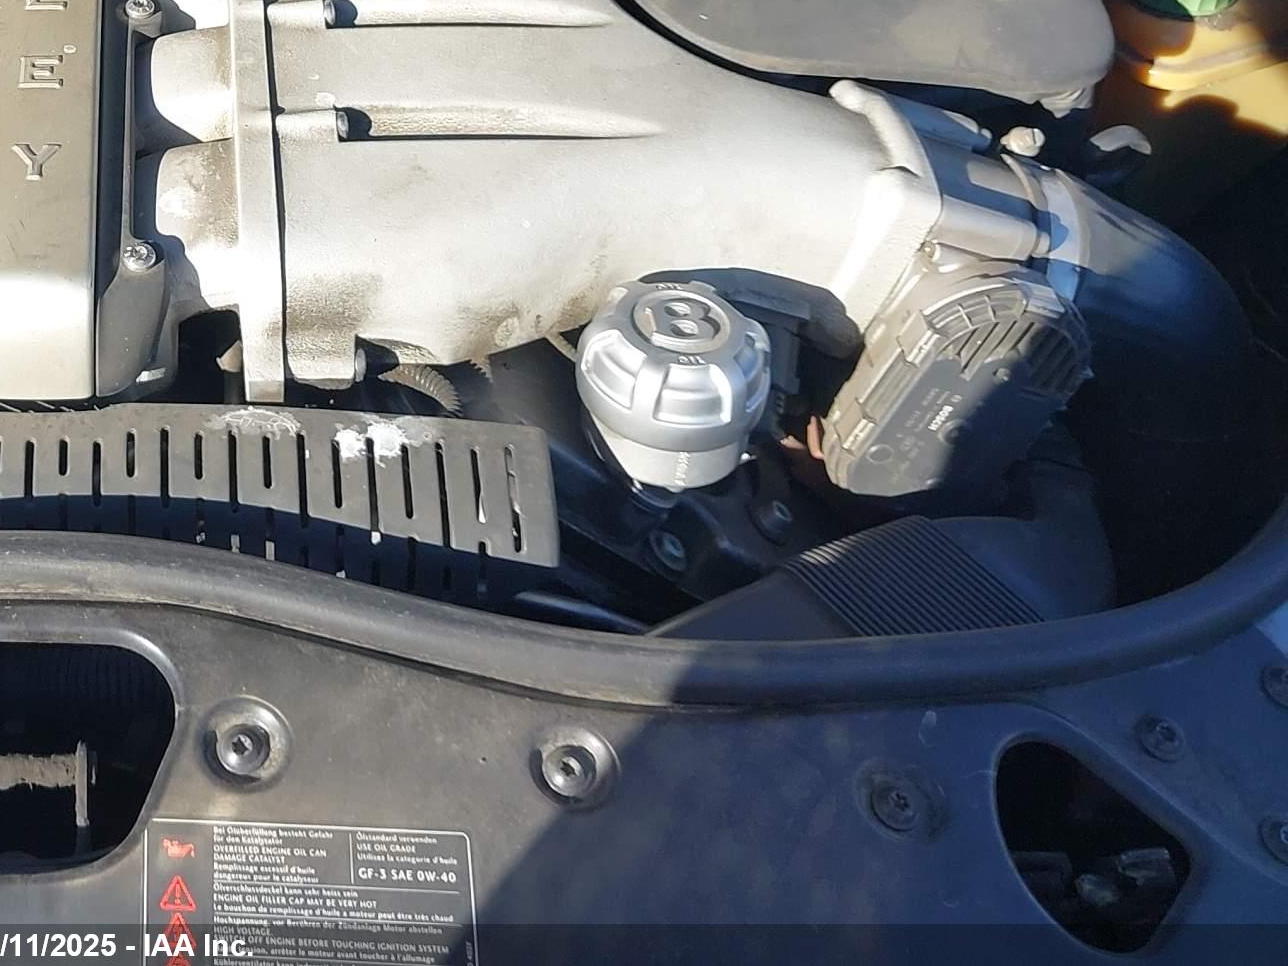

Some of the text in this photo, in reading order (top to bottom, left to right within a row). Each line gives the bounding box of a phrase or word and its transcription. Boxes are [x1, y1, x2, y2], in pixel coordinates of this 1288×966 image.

[928, 405, 954, 431] BOSCH
[226, 834, 240, 843] den
[241, 835, 283, 845] Katalysator
[398, 835, 437, 844] verwenden
[213, 844, 327, 857] OVERFILLED ENGINE OIL CAN
[356, 843, 416, 854] USE OIL GRADE
[213, 853, 285, 864] DAMAGE CATALYST
[386, 853, 394, 862] la
[432, 856, 458, 865] d'huile
[213, 862, 316, 875] Remplissage excessif d'huile
[358, 867, 457, 883] GF-3 SAE 0W-40
[253, 874, 271, 882] pour
[213, 881, 359, 898] Ölverschlussdeckel kann sehr heiss sein
[213, 893, 377, 909] ENGINE OIL FILLER CAP MAY BE VERY HOT
[213, 903, 222, 911] Le
[223, 903, 257, 912] bouchon
[258, 904, 268, 913] de
[269, 906, 314, 916] remplissage
[315, 907, 341, 917] d'huile
[349, 910, 376, 919] moteur
[377, 912, 396, 921] peut
[431, 914, 454, 923] chaud
[213, 925, 234, 935] HIGH
[322, 920, 335, 929] der
[338, 921, 381, 933] Zündanlage
[383, 922, 406, 932] Motor
[408, 924, 442, 934] abstellen
[248, 935, 264, 944] OFF
[265, 936, 296, 946] ENGINE
[298, 937, 329, 948] BEFORE
[331, 939, 376, 950] TOUCHING
[377, 941, 416, 952] IGNITION
[418, 944, 450, 954] SYSTEM
[298, 948, 306, 956] le
[308, 949, 335, 958] moteur
[336, 951, 357, 960] avant
[359, 952, 388, 961] toucher
